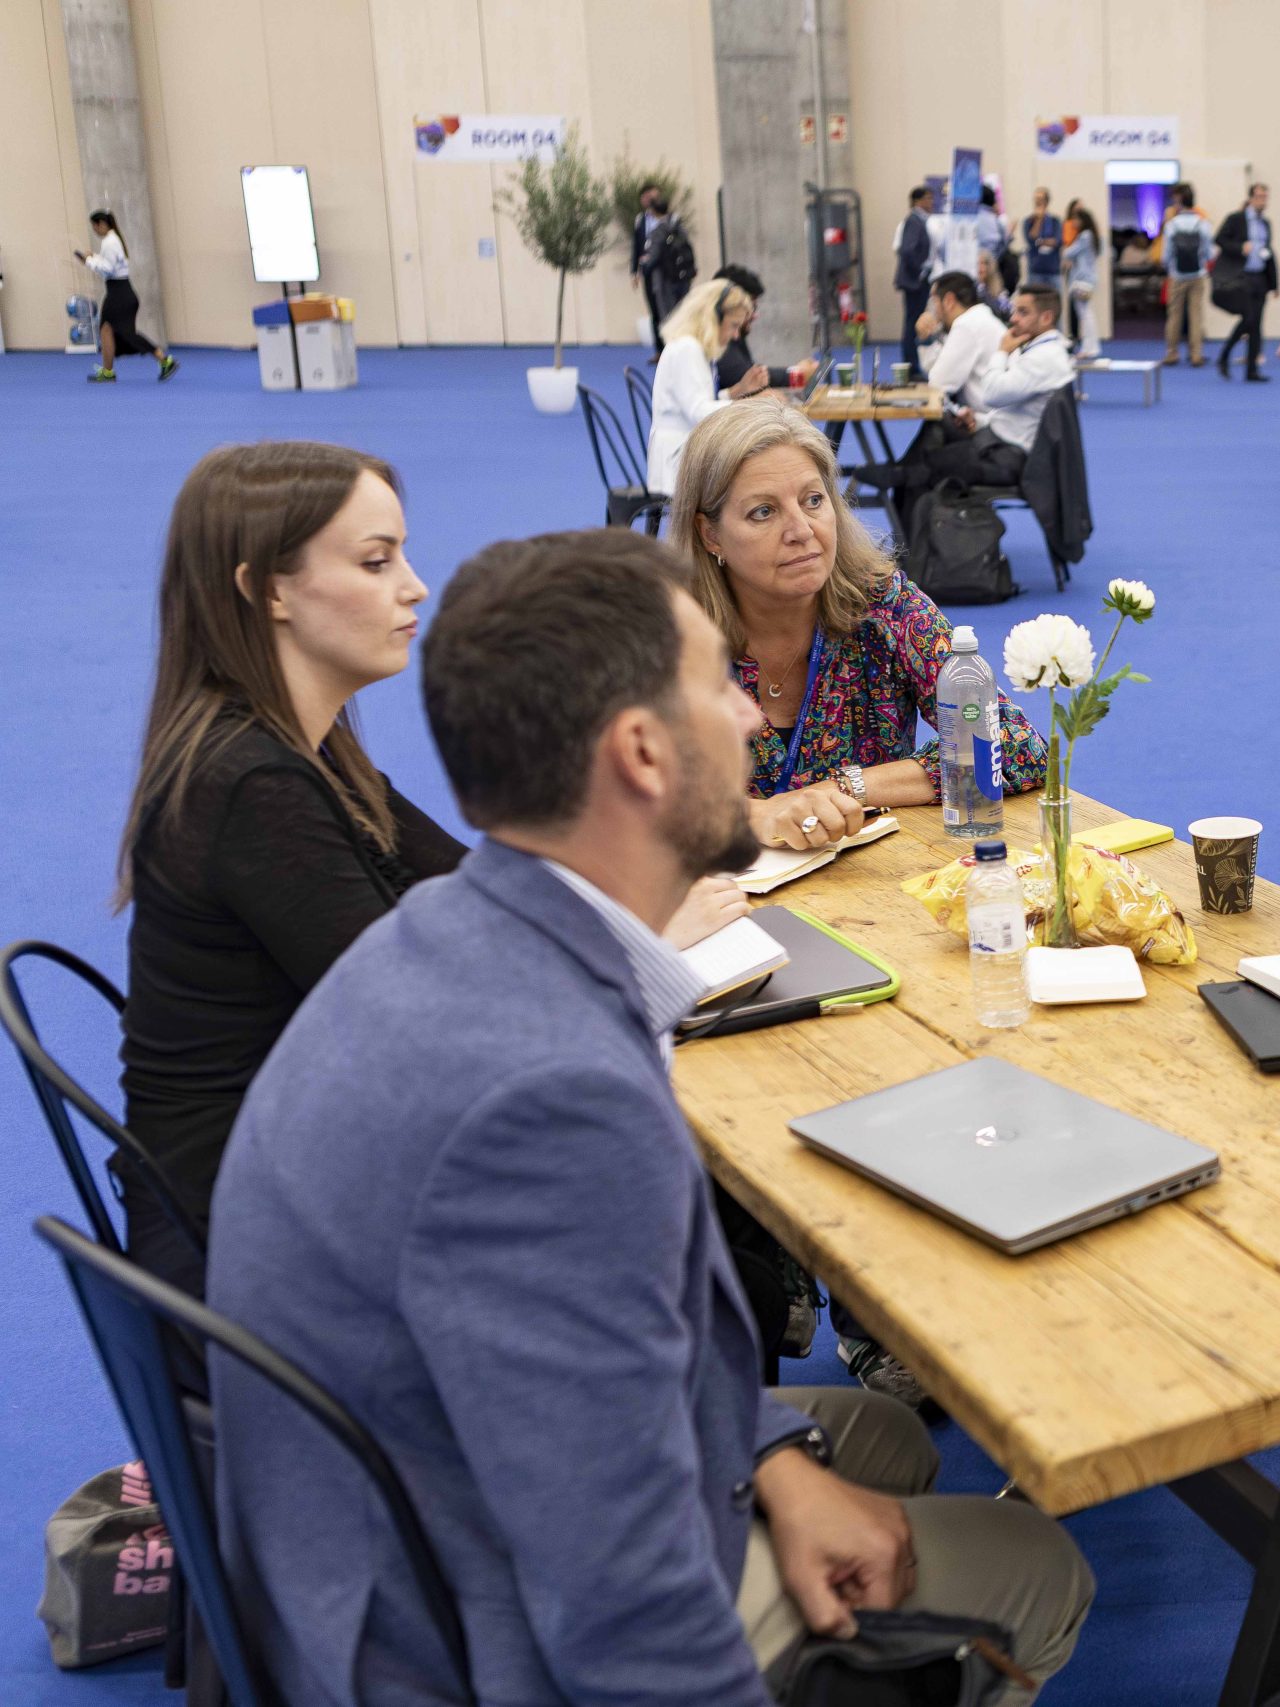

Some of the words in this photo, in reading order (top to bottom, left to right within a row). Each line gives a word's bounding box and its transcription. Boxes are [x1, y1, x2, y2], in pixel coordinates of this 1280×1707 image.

[472, 129, 526, 148] ROOM
[1089, 130, 1143, 146] ROOM
[985, 701, 1002, 788] smart
